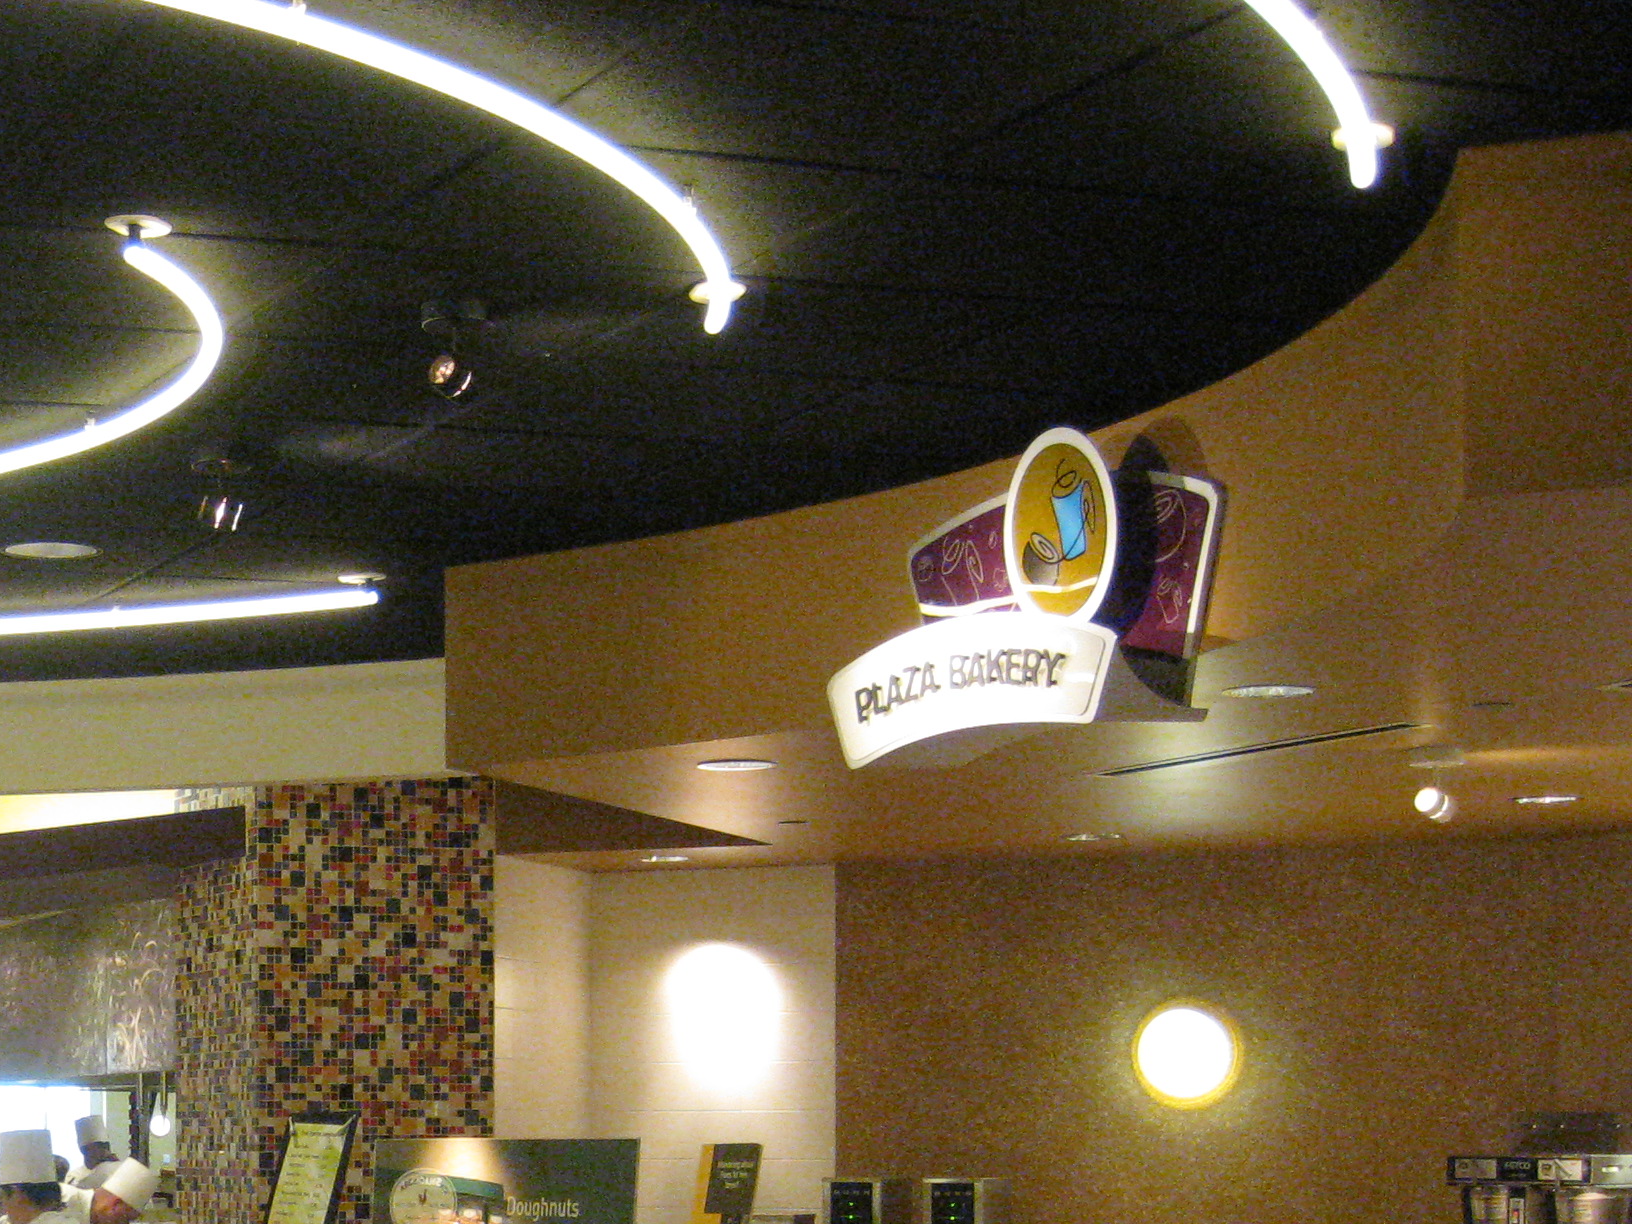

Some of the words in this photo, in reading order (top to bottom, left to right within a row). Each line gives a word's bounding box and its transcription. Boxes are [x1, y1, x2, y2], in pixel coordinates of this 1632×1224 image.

[854, 661, 942, 725] PLAZA
[948, 648, 1067, 690] BAKERY
[504, 1195, 580, 1222] Doughnuts
